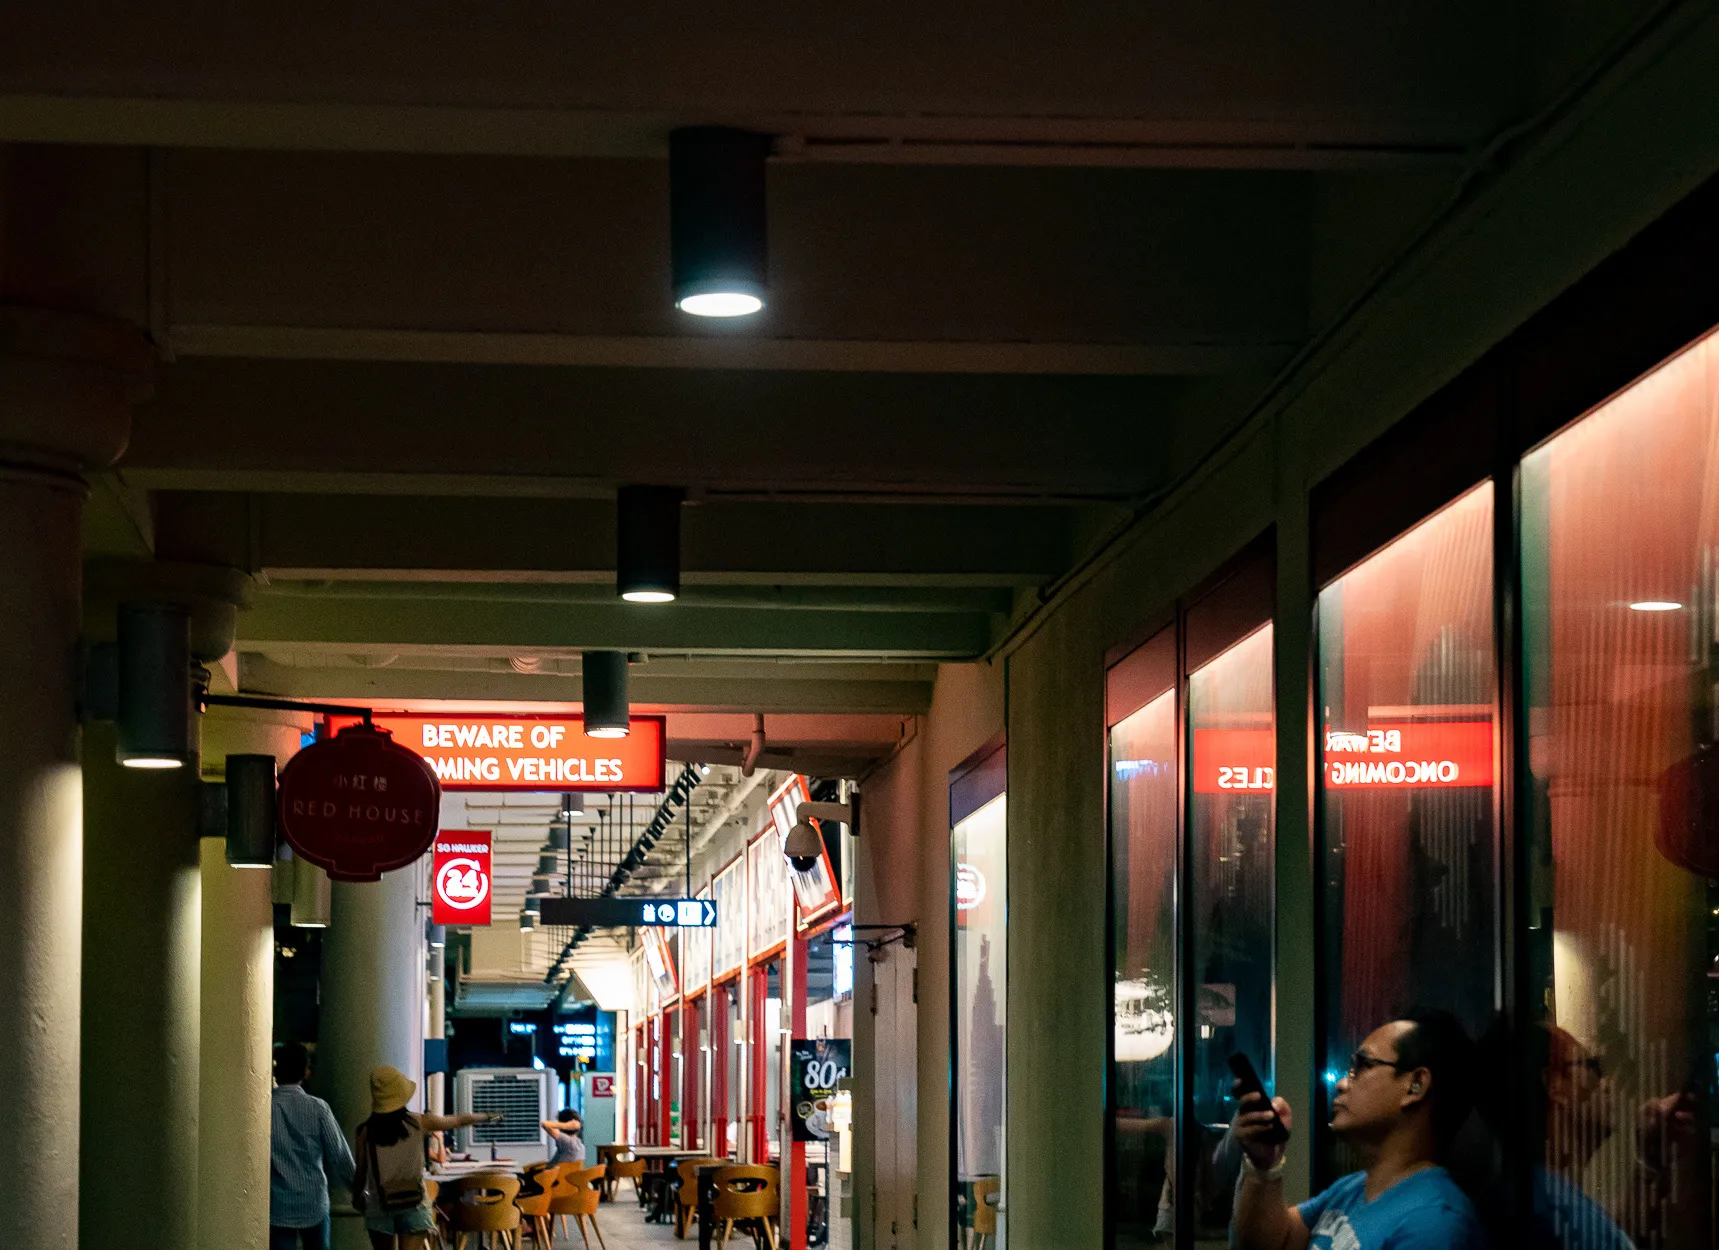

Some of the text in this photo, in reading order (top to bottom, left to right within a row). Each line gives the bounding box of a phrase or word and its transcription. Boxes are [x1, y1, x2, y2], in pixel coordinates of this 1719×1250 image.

[422, 724, 565, 748] BEWARE OF
[506, 758, 623, 781] VEHICLES
[293, 800, 422, 824] RED HOUSE
[446, 868, 479, 897] 24
